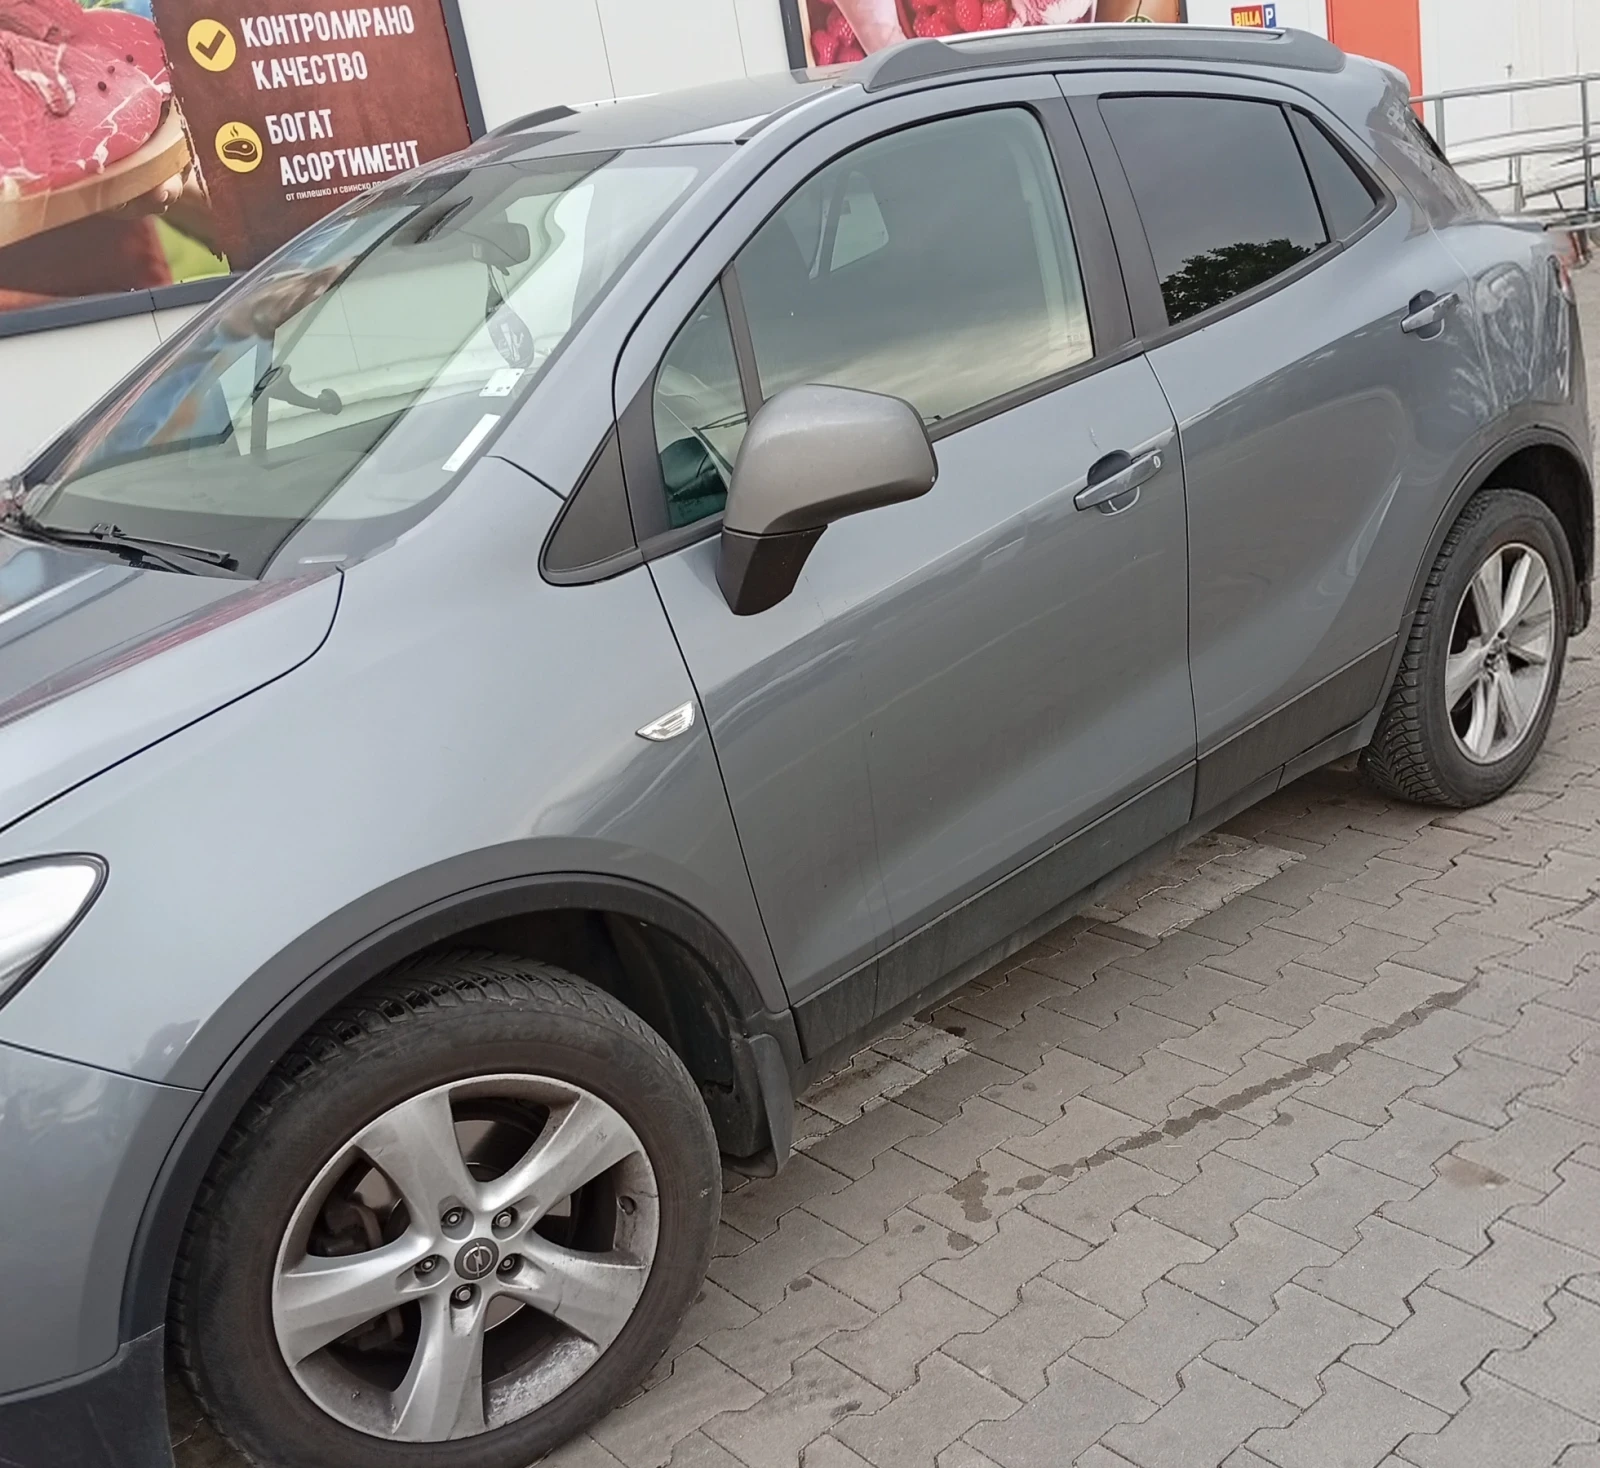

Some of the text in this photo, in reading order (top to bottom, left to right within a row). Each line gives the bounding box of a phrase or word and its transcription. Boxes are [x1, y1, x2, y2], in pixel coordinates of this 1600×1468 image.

[240, 5, 415, 48] КОНТРОЛИРАНО
[1233, 8, 1274, 26] BILLA P
[251, 51, 368, 90] КАЧЕСТВО
[265, 109, 333, 144] БОГАТ
[280, 140, 420, 185] АСОРТИМЕНТ
